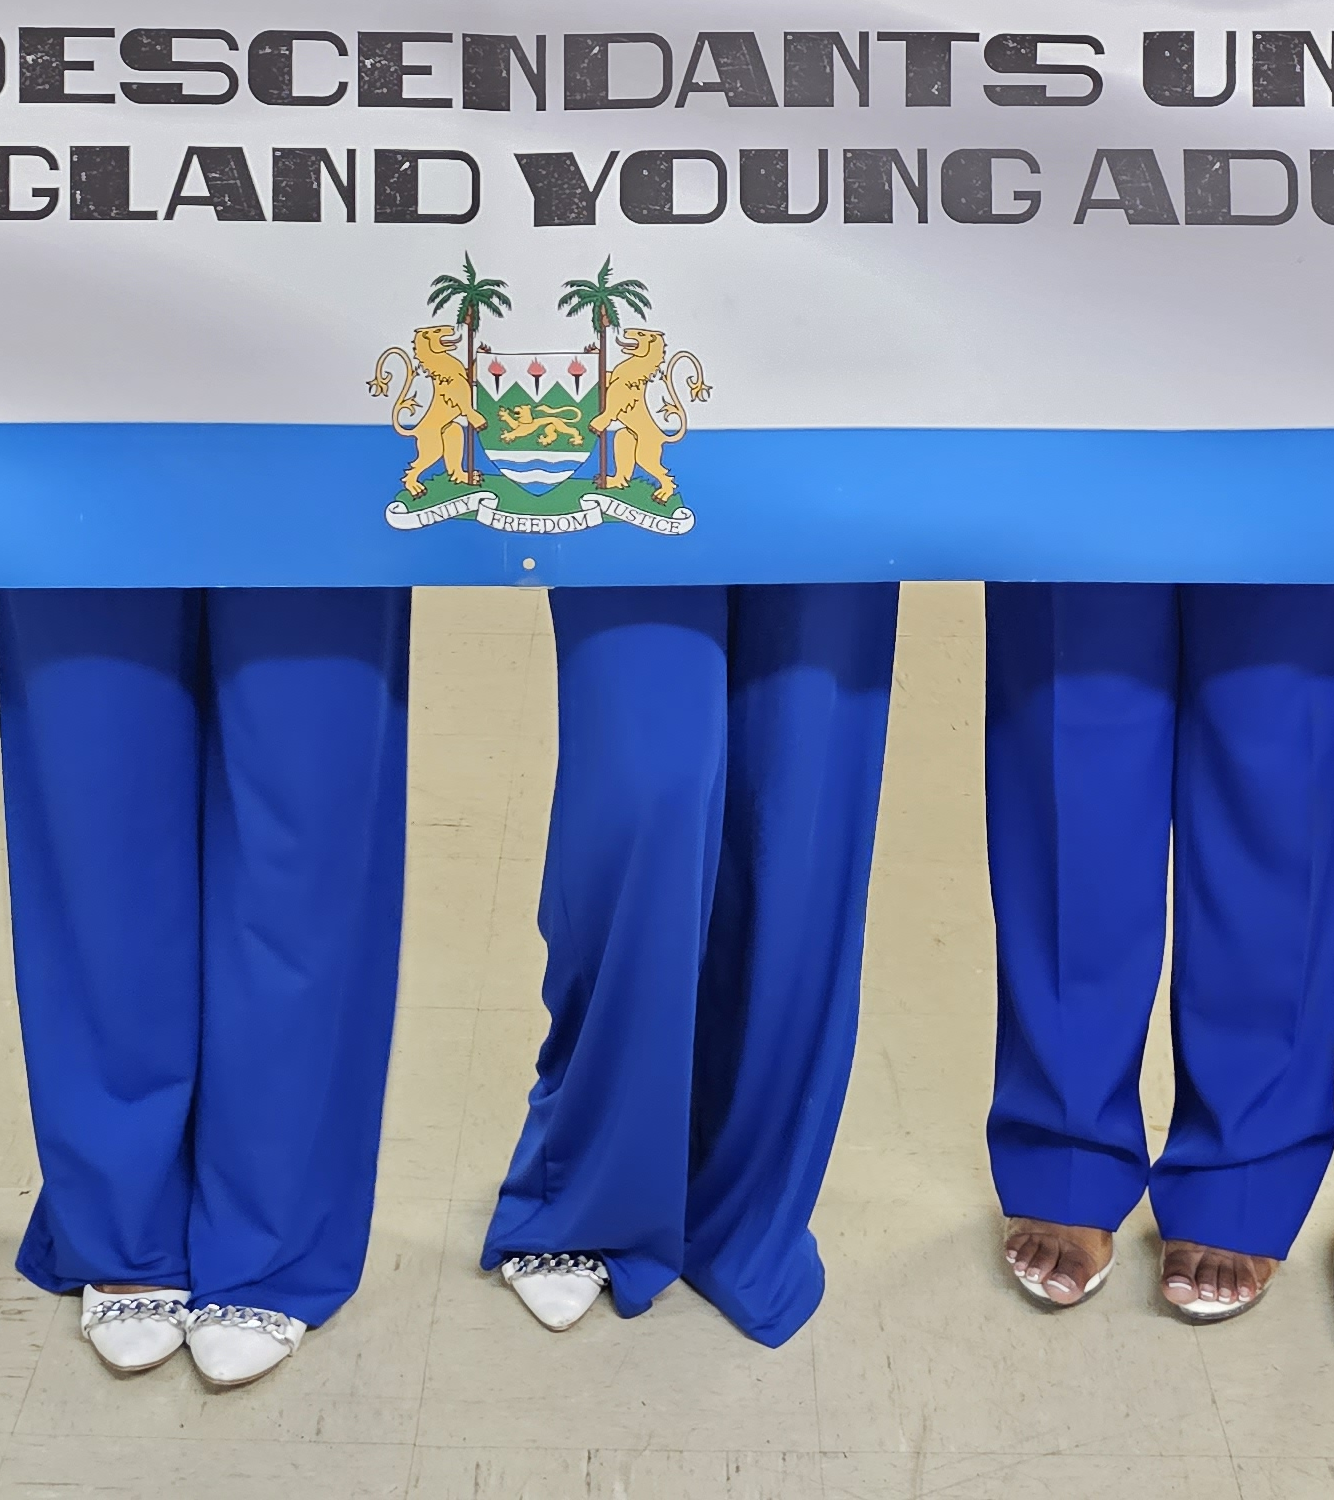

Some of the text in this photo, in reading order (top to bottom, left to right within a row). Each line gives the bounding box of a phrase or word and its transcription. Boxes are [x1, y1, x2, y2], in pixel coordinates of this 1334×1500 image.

[513, 149, 1042, 227] YOUNG
[416, 496, 682, 534] UNITY FREEDOM JUSTICE
